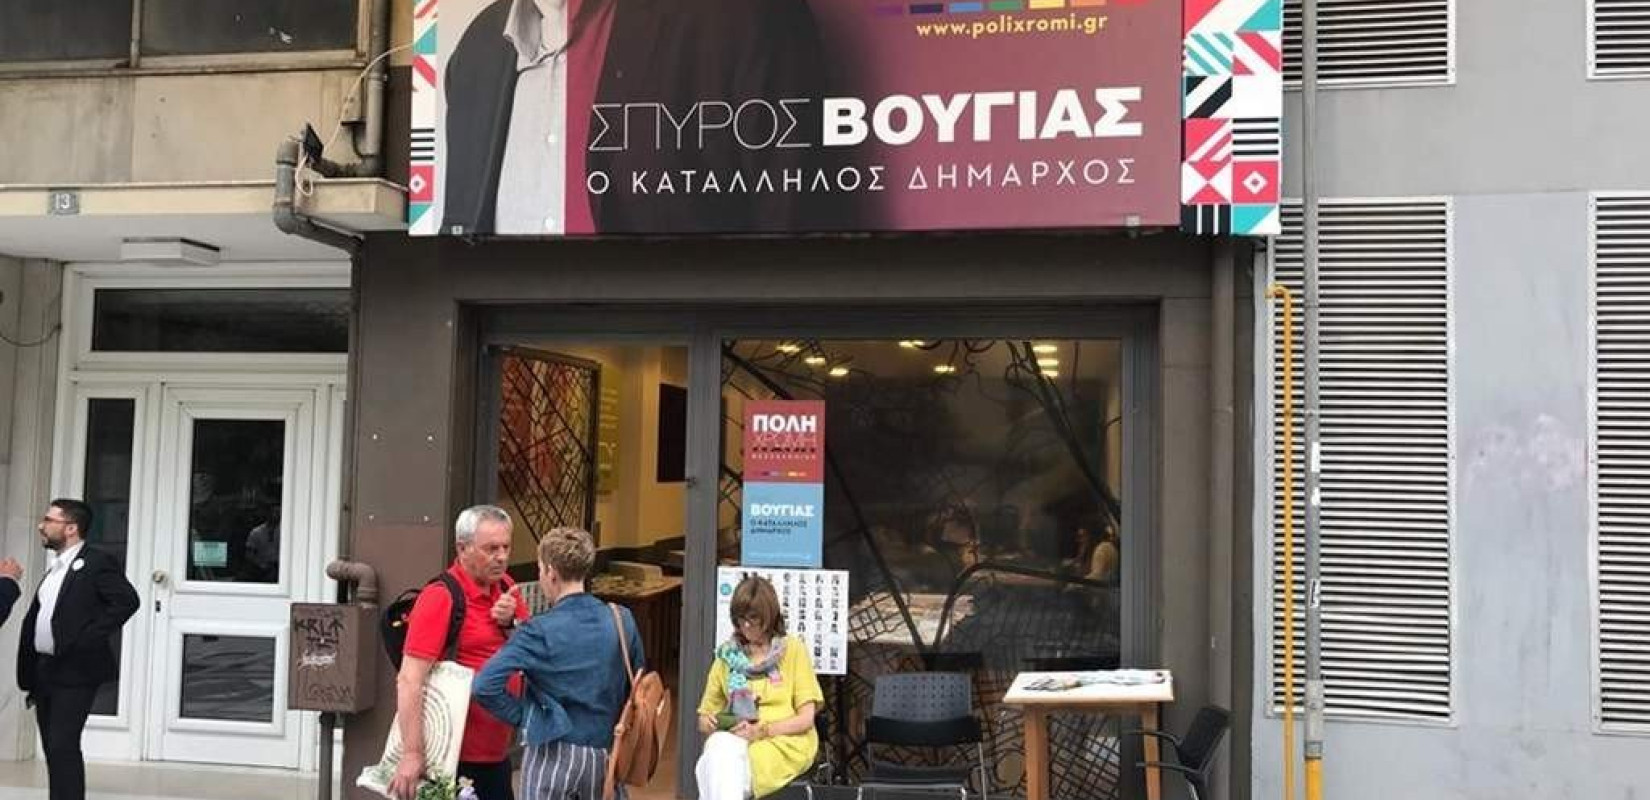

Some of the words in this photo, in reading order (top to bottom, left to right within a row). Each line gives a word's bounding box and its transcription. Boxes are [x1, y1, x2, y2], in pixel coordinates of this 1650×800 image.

[916, 14, 1108, 38] www.polixromi.gr
[588, 98, 811, 151] ΣΠΥΡΟΣ
[822, 87, 1143, 146] ΒΟΥΓΙΑΣ
[587, 171, 610, 194] Ο
[632, 166, 885, 194] ΚΑΤΑΛΛΗΛΟΣ
[908, 159, 1136, 190] ΔΗΜΑΡΧΟΣ
[56, 193, 70, 209] 13
[753, 414, 817, 433] ΠΟΛΗ
[751, 504, 815, 517] ΒΟΥΓΙΑΣ
